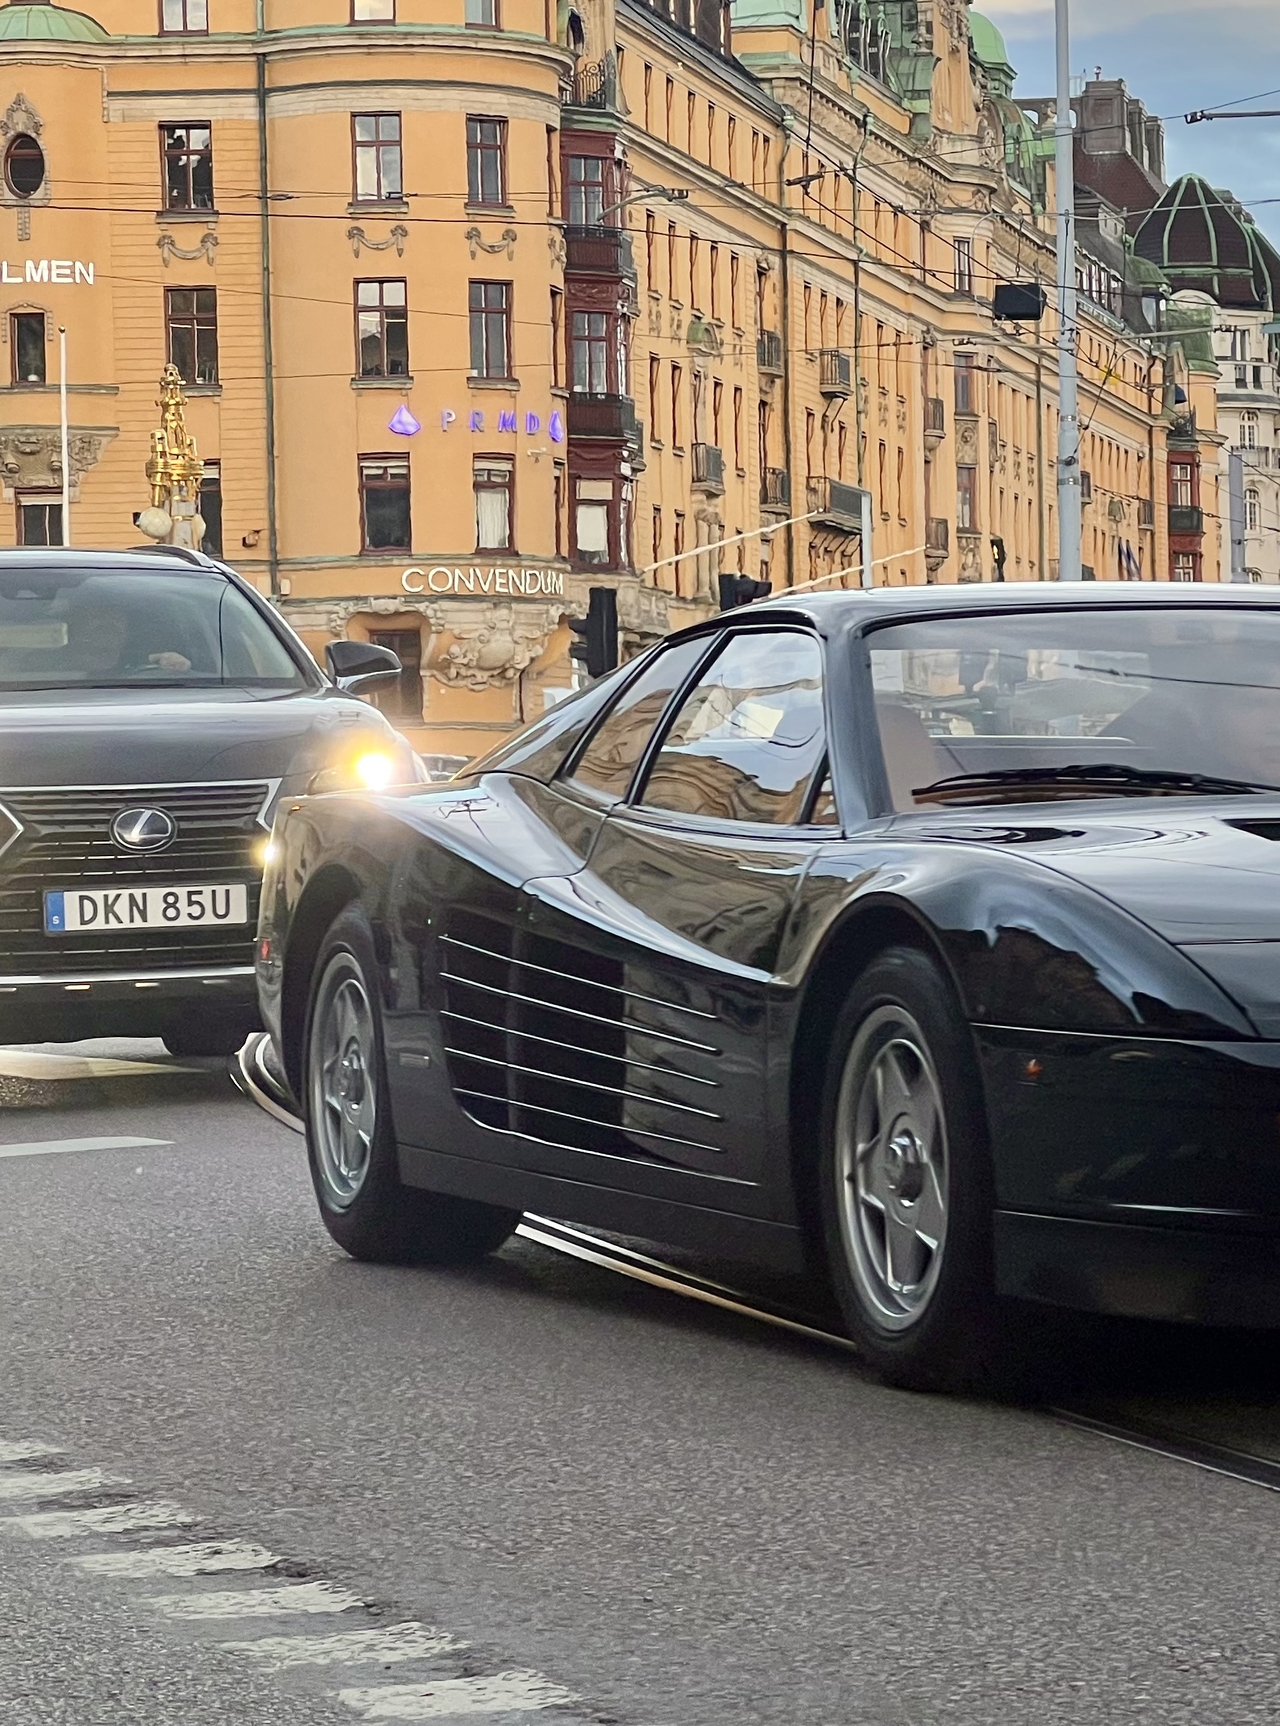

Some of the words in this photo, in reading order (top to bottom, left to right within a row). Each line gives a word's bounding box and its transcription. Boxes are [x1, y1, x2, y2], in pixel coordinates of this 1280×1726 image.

[401, 567, 564, 595] CONVENDUM
[52, 916, 60, 925] S
[78, 892, 148, 926] DKN
[161, 888, 231, 922] 85U
